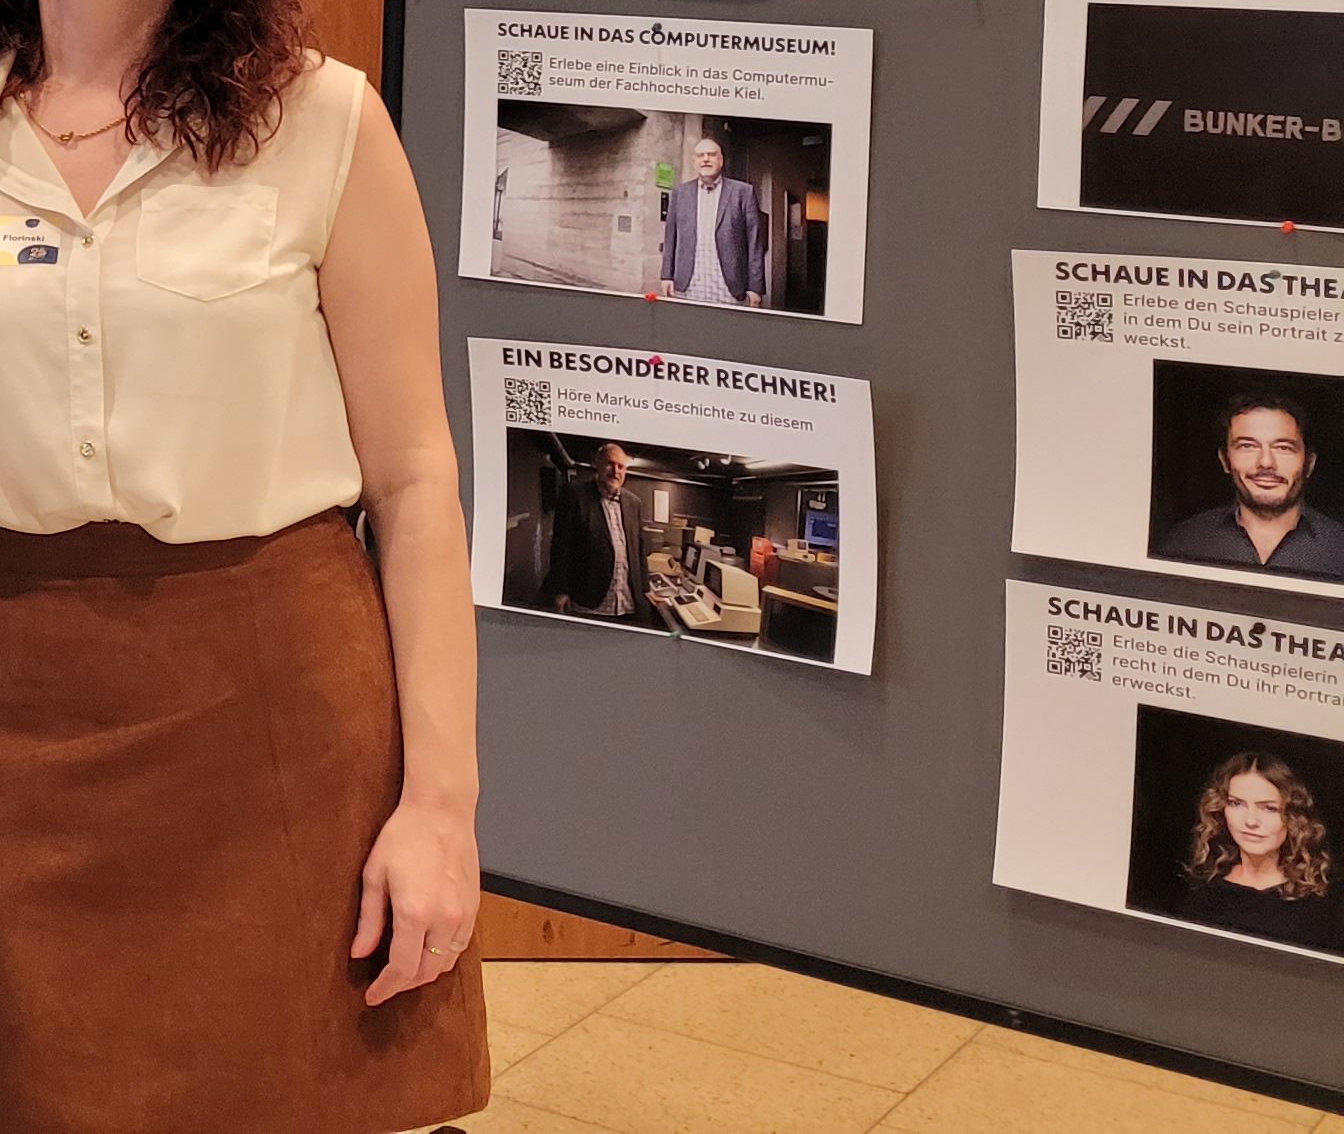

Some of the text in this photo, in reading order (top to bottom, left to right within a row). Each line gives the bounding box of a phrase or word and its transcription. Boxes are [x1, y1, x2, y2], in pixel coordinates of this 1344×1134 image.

[497, 22, 836, 56] SCHAUE IN DAS COMPUTERMUSEUM!
[548, 76, 765, 101] seum der Fachhochschule Kiel.
[549, 56, 834, 90] Erlebe eine Einblick in das Computermu-
[1183, 109, 1342, 142] BUNKER-B
[1055, 261, 1344, 299] SCHAUE IN DAS THE
[1123, 293, 1341, 324] Erlebe den Schauspieler
[1123, 311, 1138, 326] in
[1143, 314, 1182, 329] dem
[1187, 316, 1212, 332] Du
[1217, 320, 1253, 335] sein
[1259, 322, 1328, 342] Portrait
[1123, 333, 1191, 350] weckst.
[502, 347, 837, 404] EIN BESONDERER RECHNER!
[557, 387, 814, 432] Höre Markus Geschichte zu diesem
[557, 404, 620, 424] Rechner.
[1047, 596, 1344, 662] SCHAUE IN DAS THEA
[1113, 634, 1338, 686] Erlebe die Schauspielerin
[1111, 675, 1196, 700] erweckst.
[1112, 656, 1344, 707] recht in dem Du ihr Portra
